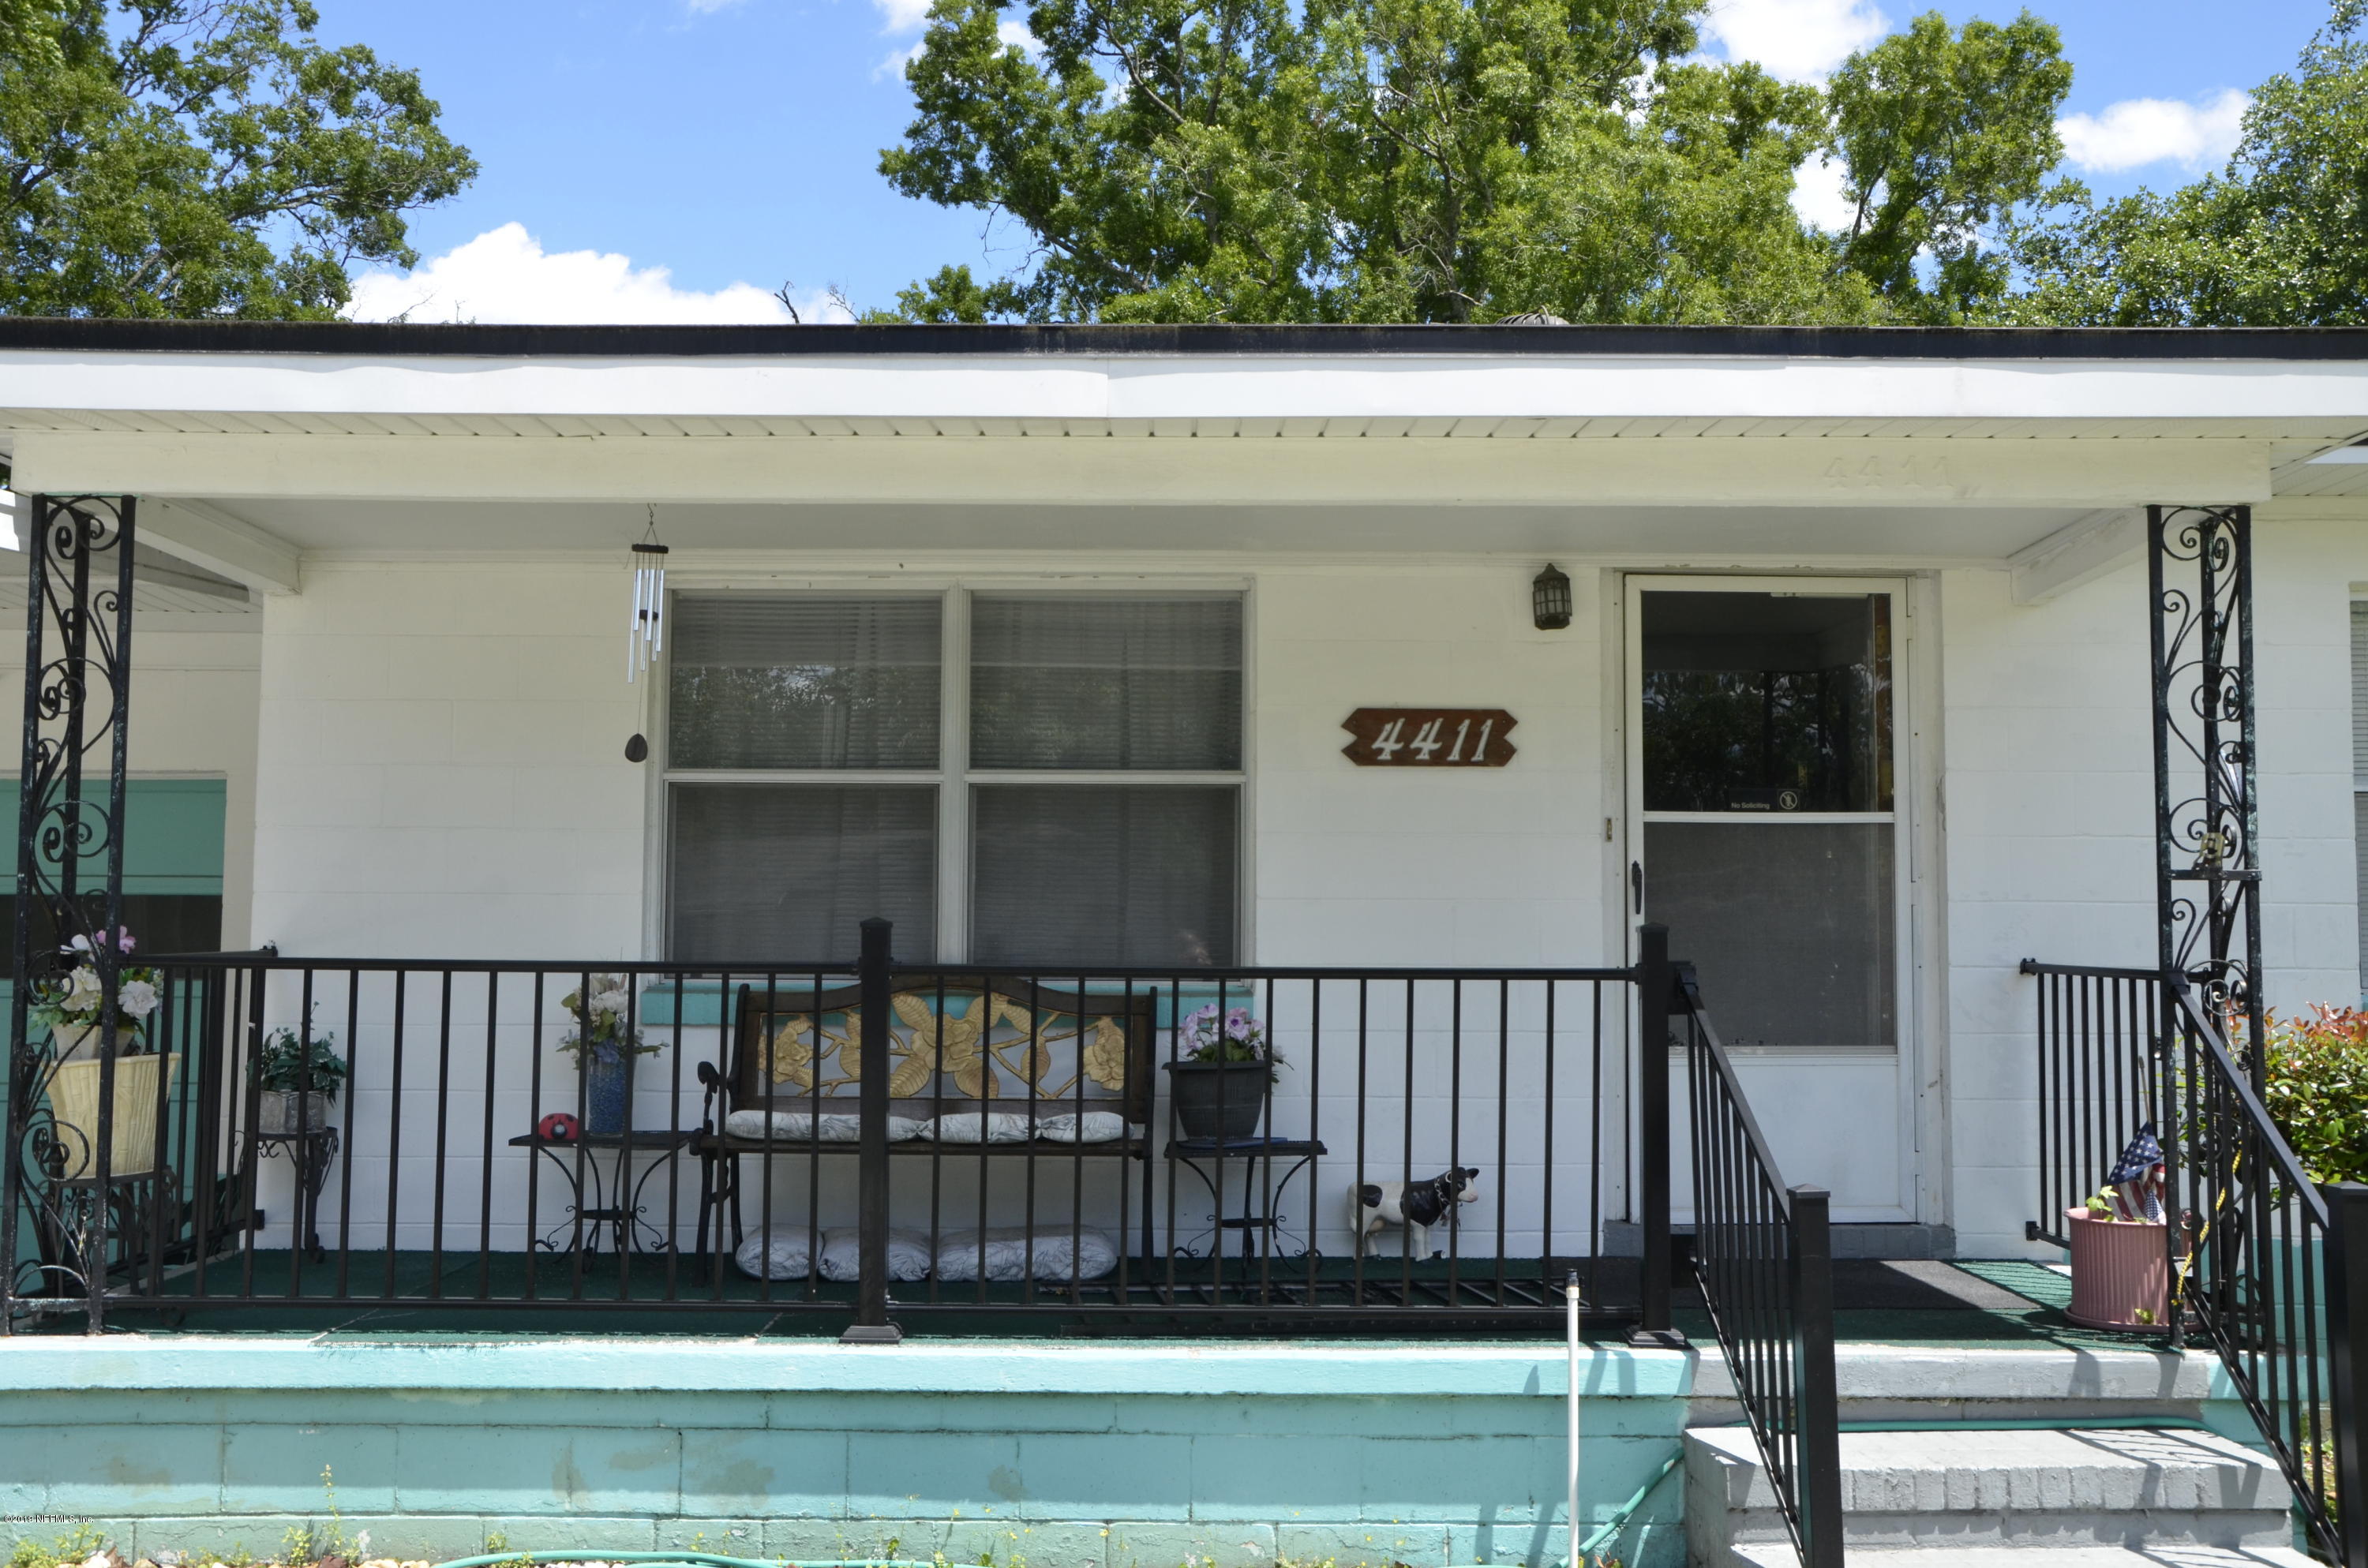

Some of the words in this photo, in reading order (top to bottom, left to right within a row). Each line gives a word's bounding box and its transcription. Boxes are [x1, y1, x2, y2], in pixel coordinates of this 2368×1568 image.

[1823, 455, 1954, 489] 4411
[1370, 717, 1493, 762] 4411
[1741, 802, 1770, 810] Soliciting
